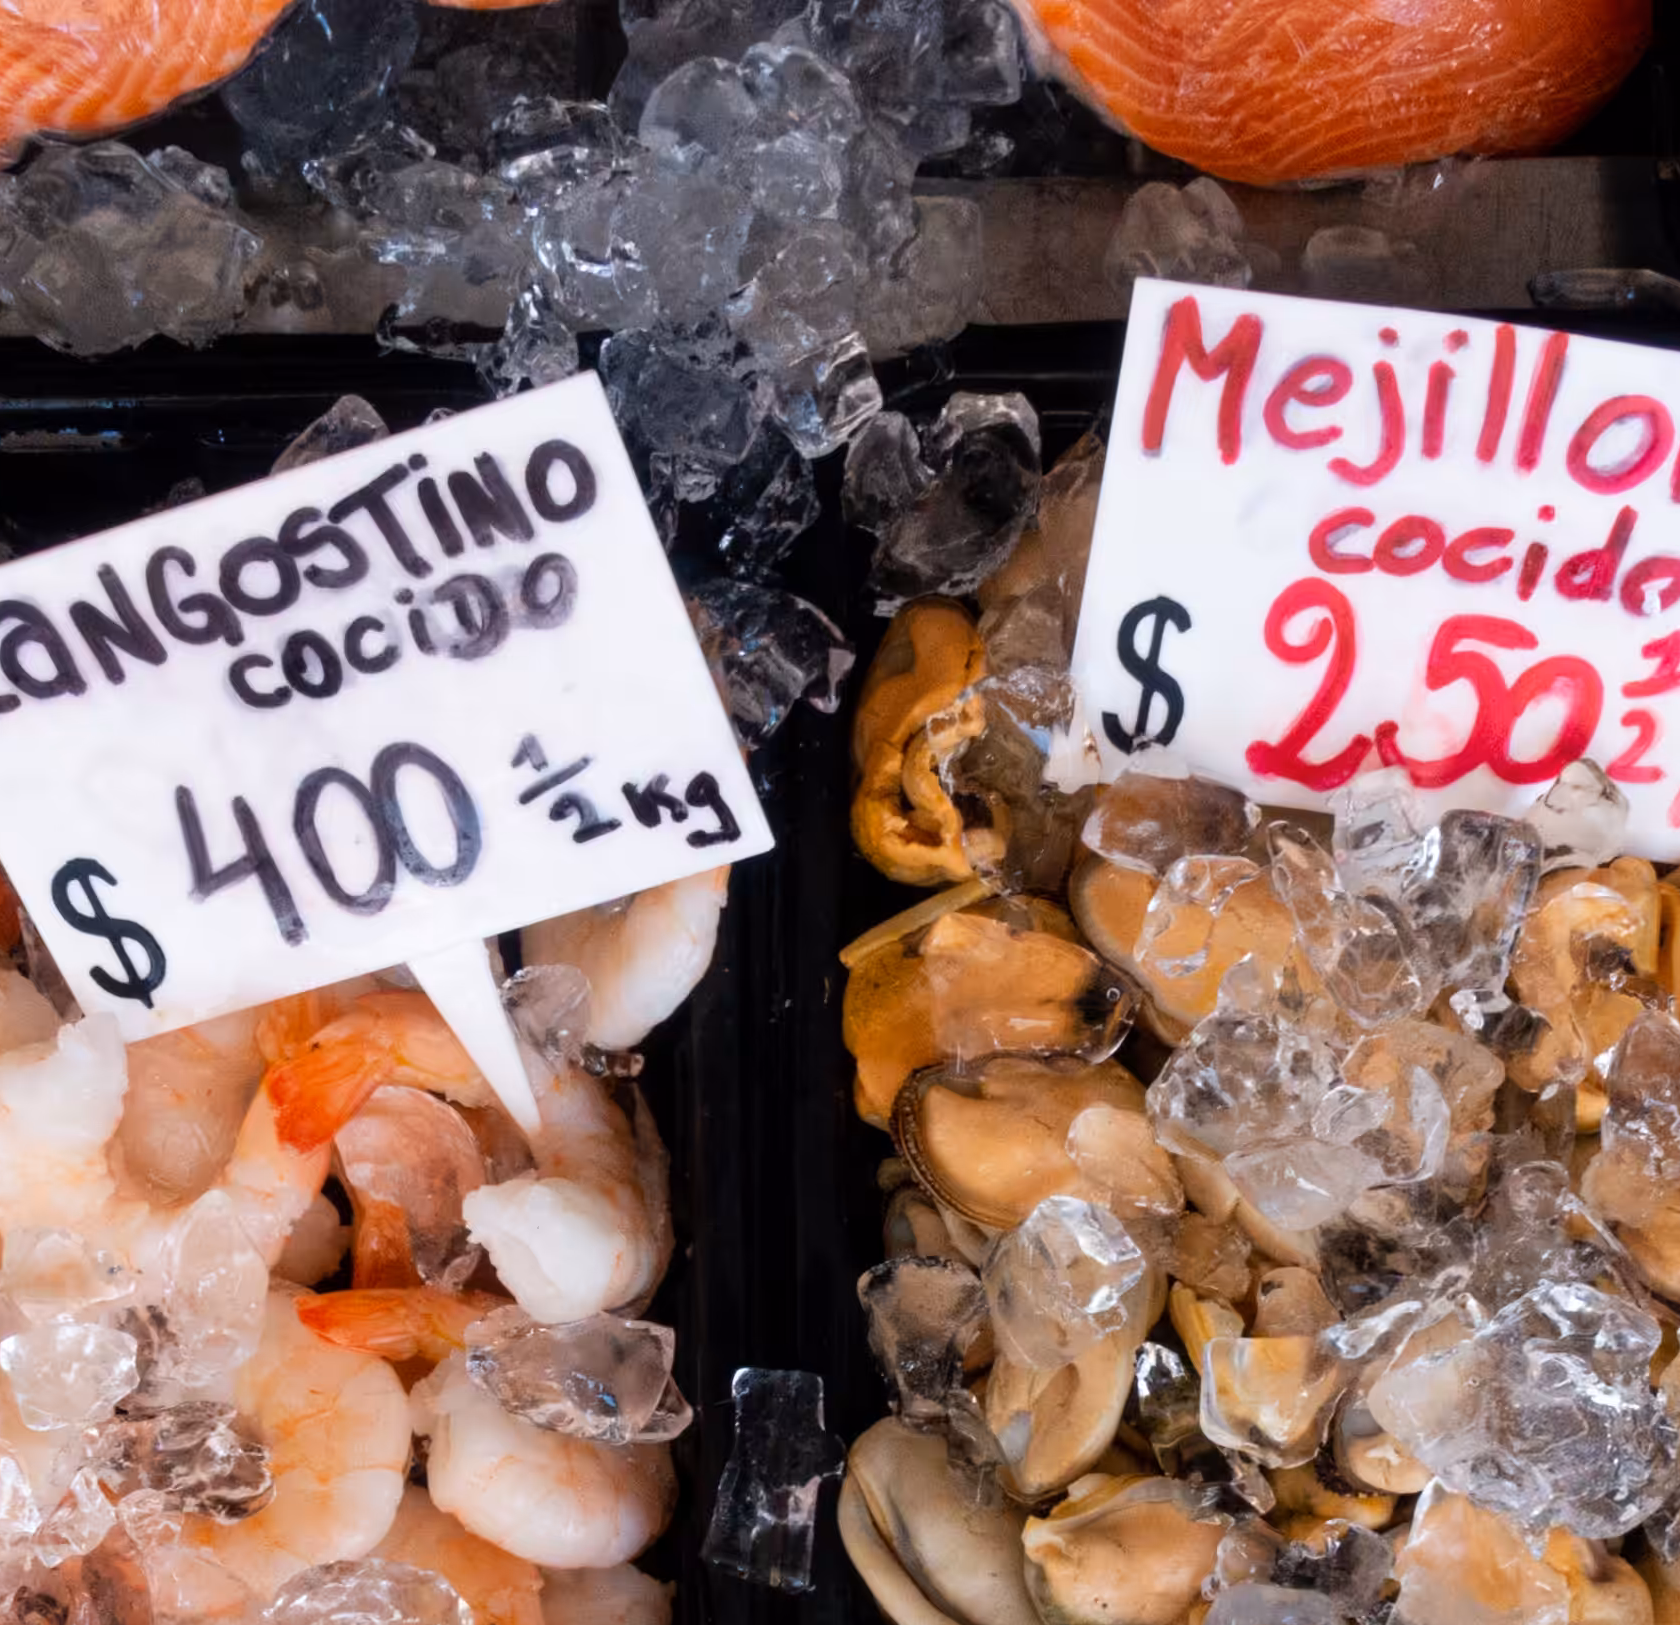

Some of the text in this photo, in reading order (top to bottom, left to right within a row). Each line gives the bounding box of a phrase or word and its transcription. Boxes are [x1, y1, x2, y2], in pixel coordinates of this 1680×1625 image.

[1102, 596, 1191, 754] $
[50, 857, 167, 1008] $
[174, 741, 483, 946] 400
